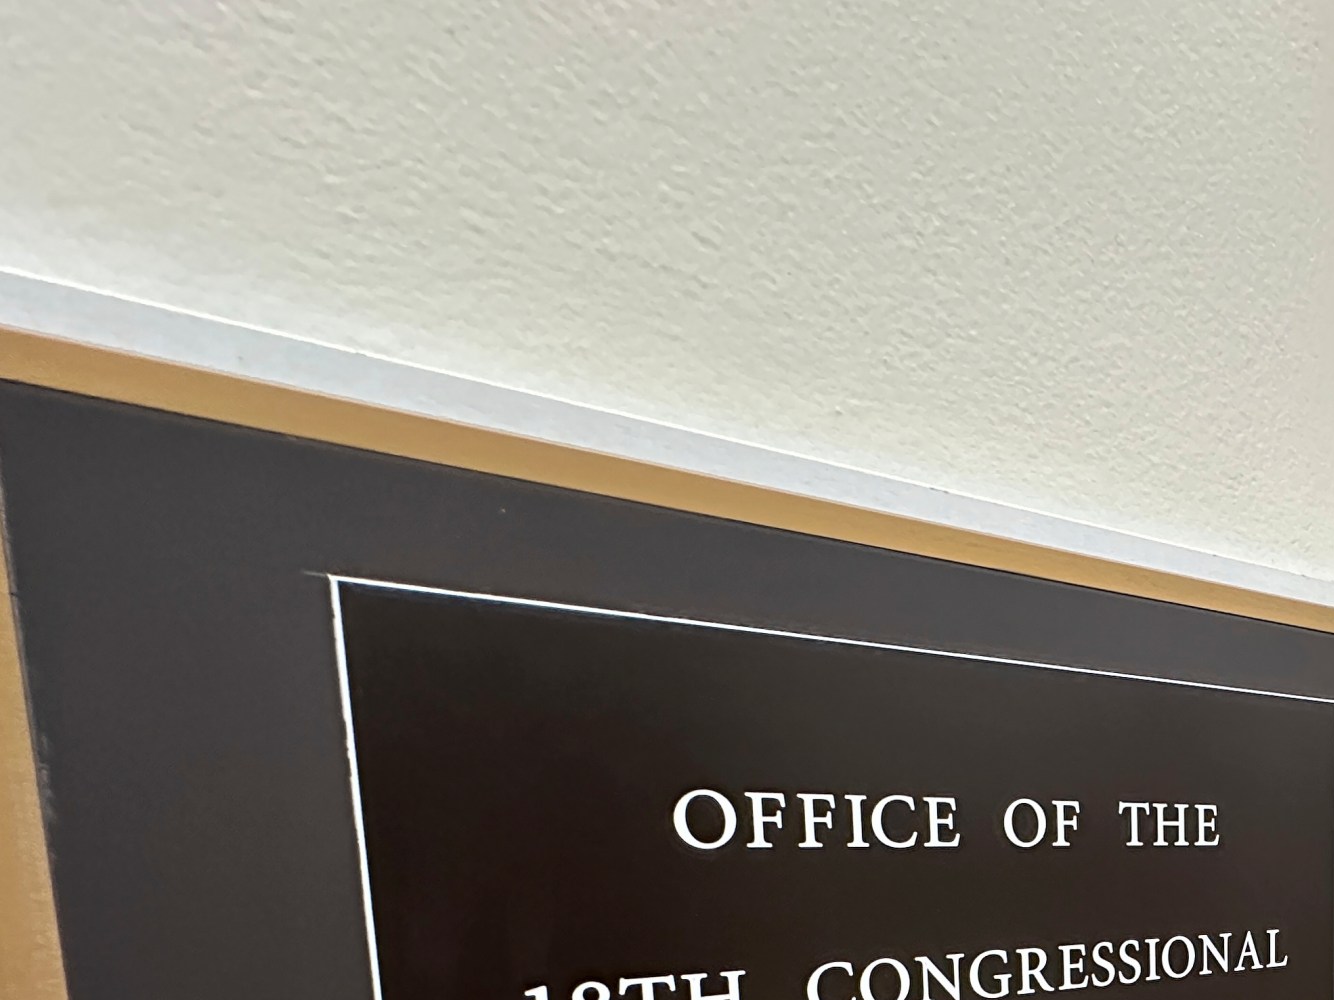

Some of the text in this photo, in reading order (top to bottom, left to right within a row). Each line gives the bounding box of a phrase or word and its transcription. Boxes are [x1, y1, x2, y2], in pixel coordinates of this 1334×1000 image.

[673, 789, 1220, 850] OFFICE OF THE
